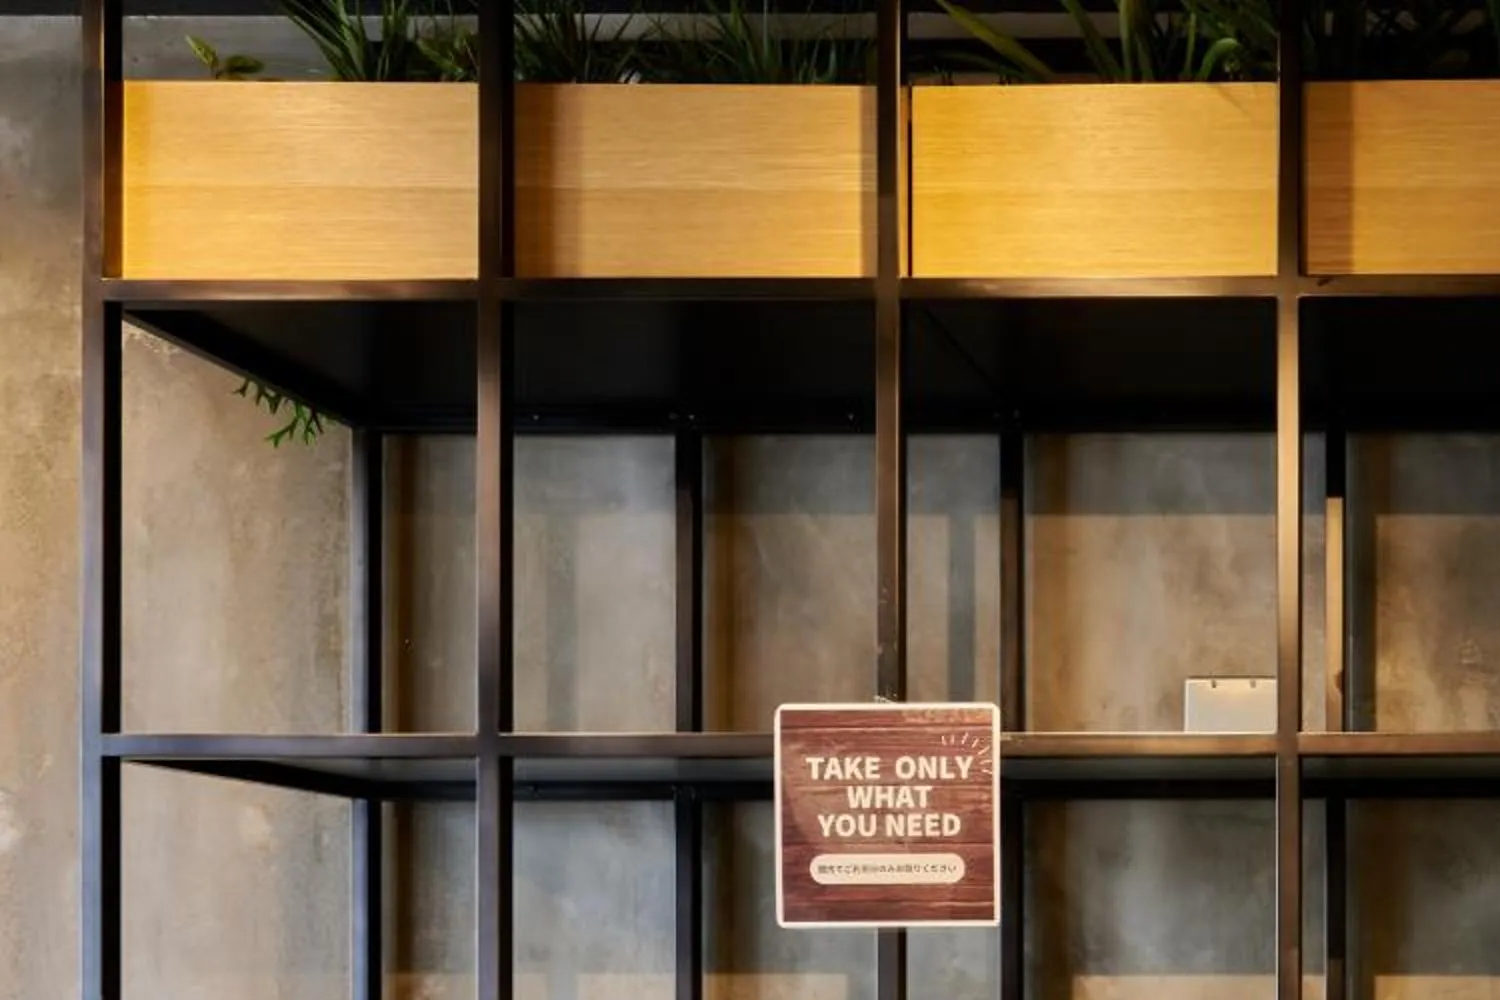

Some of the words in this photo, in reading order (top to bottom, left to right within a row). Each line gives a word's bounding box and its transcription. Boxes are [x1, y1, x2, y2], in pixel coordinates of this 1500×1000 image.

[806, 756, 881, 781] TAKE
[895, 756, 974, 780] ONLY
[847, 785, 933, 809] WHAT
[817, 813, 877, 837] YOU
[885, 813, 961, 837] NEED
